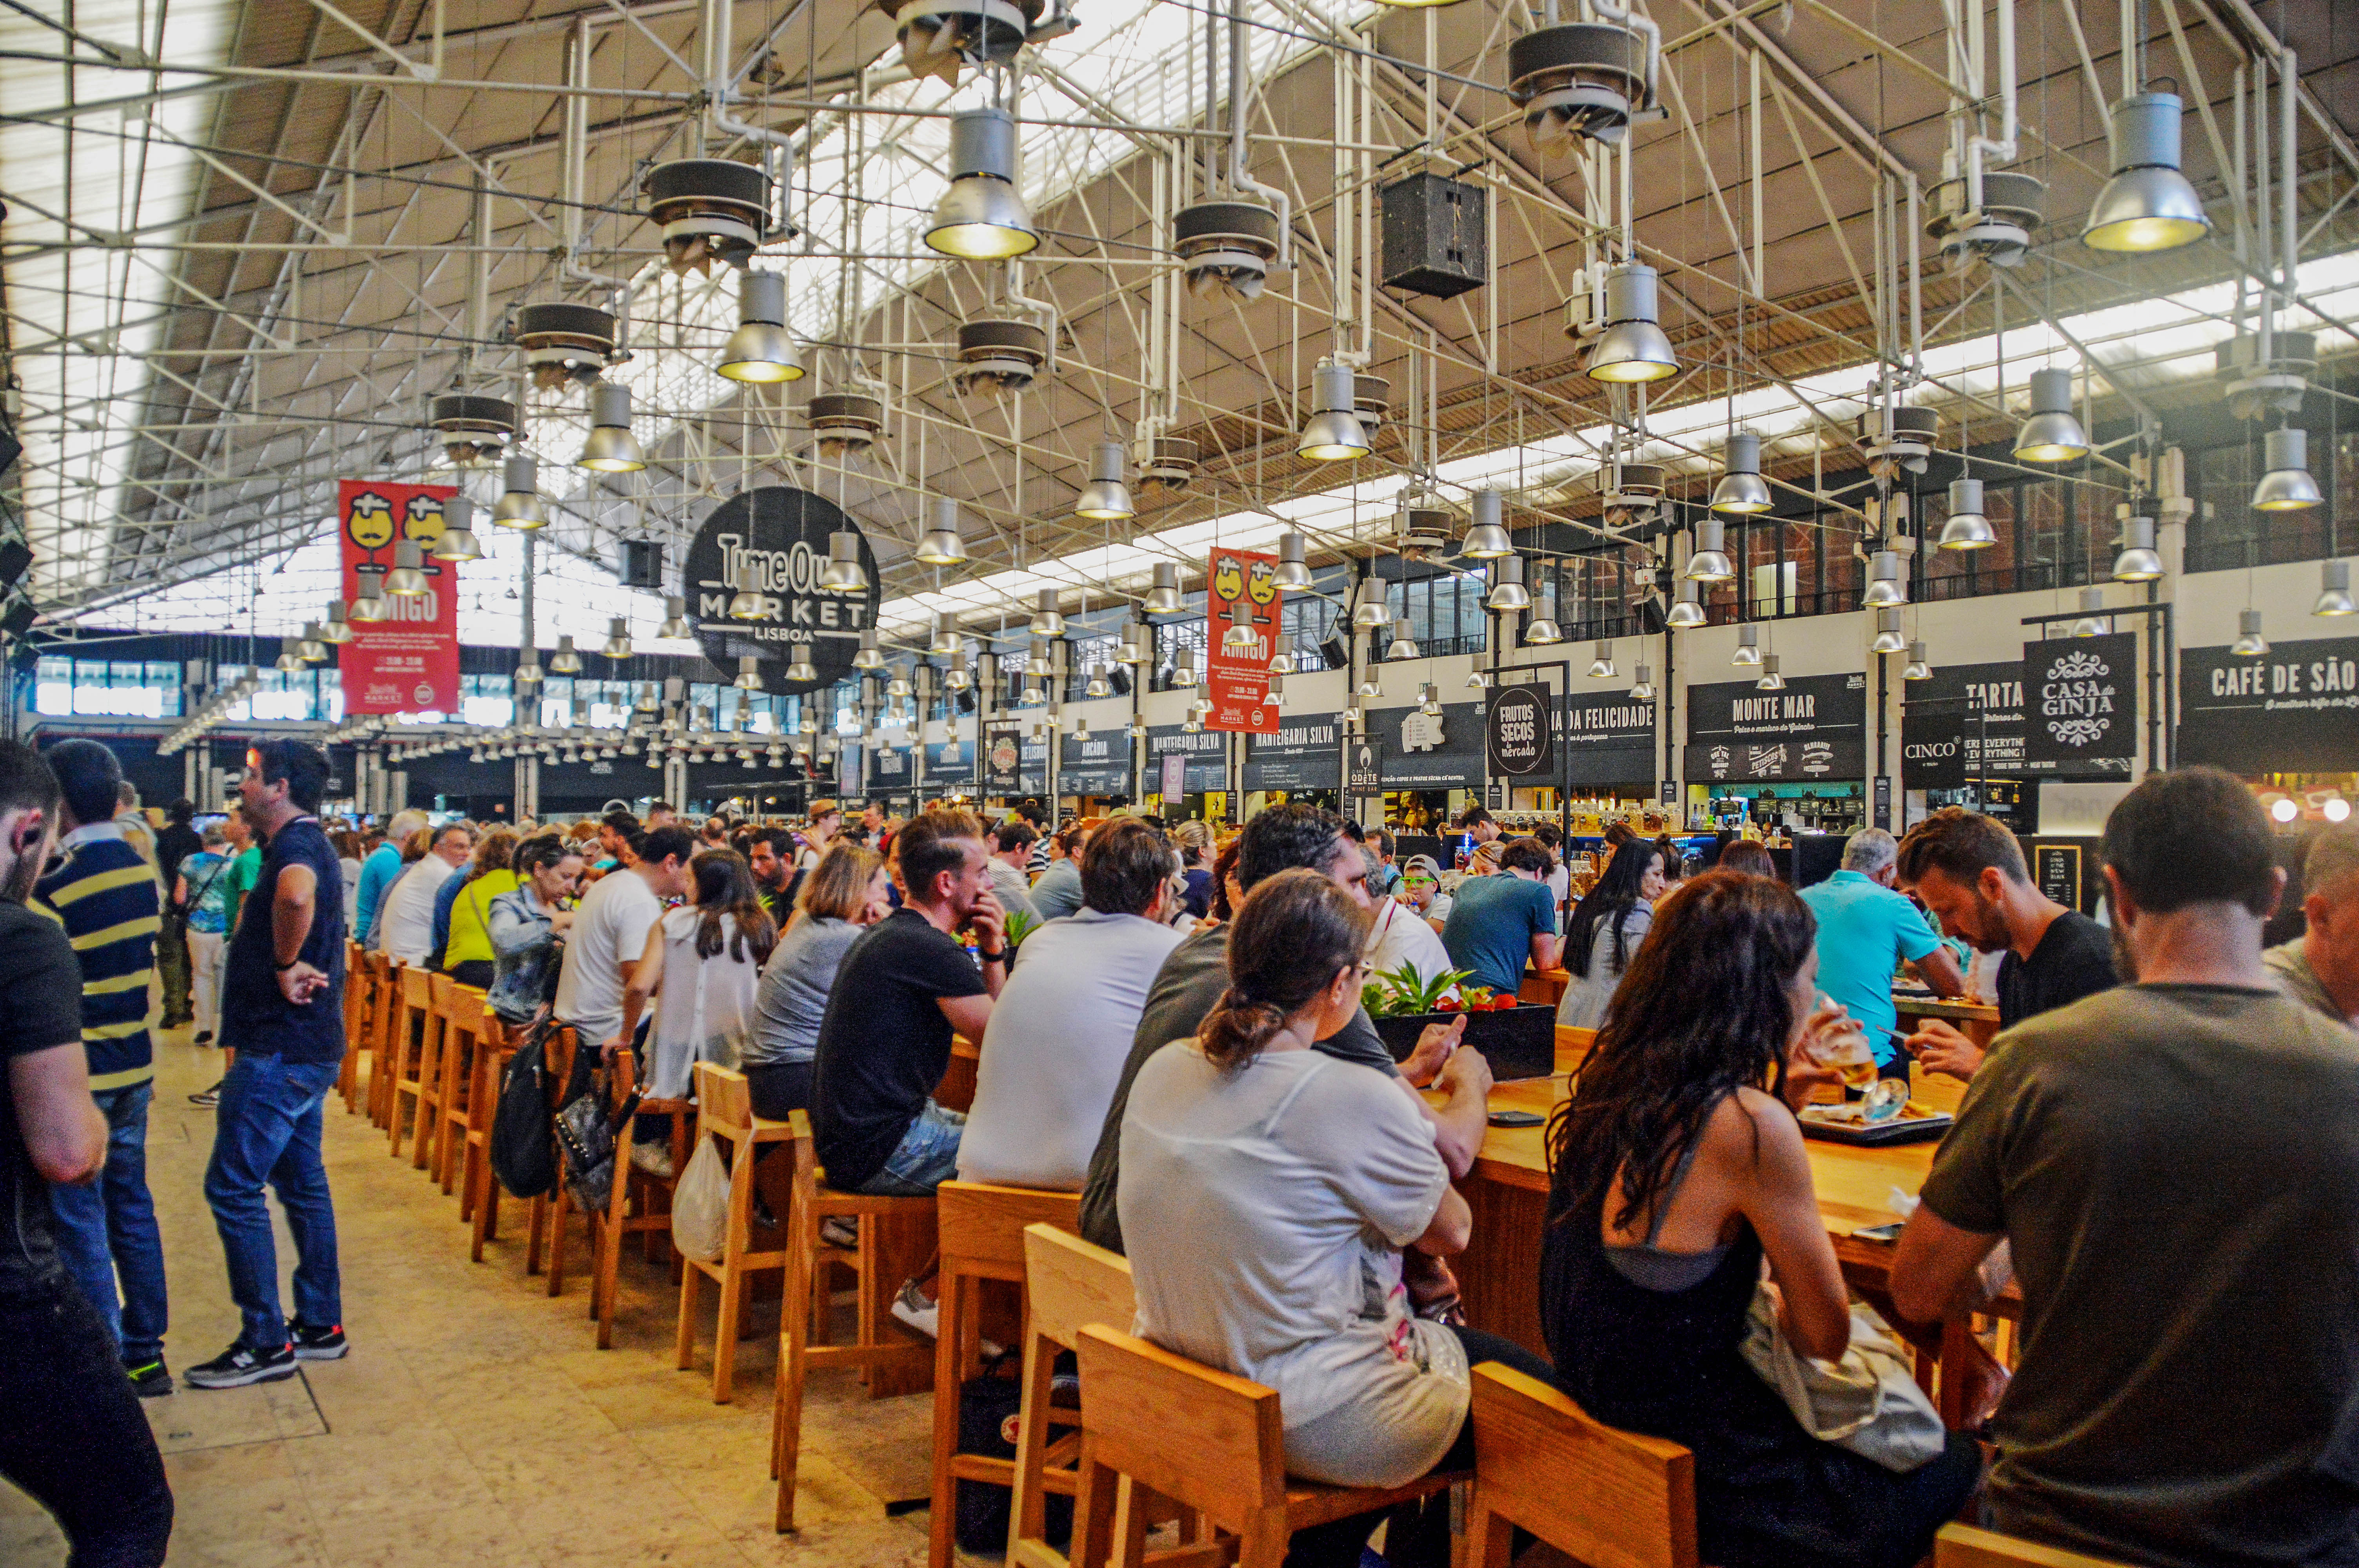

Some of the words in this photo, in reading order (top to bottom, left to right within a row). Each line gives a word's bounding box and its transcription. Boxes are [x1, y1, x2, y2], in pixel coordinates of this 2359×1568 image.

[379, 589, 438, 622] MIGO
[700, 593, 866, 628] MRKET
[755, 627, 813, 642] LISBOA
[2212, 660, 2265, 697] CAFÉ
[2272, 664, 2301, 693] DE
[2310, 656, 2356, 692] SÃO
[2042, 681, 2102, 699] CASA
[1500, 704, 1534, 722] FRUTOS
[1733, 697, 1779, 721] MONTE
[1785, 695, 1815, 718] MAR
[2042, 696, 2114, 717] GINJA
[1585, 705, 1653, 729] FELICIDADE
[1256, 727, 1308, 747] MANTEIGARIA
[1310, 726, 1334, 744] SILVA
[1501, 721, 1535, 742] SECOS
[1789, 723, 1816, 733] Guincho
[1082, 739, 1107, 756] ARCÁDIA
[1153, 734, 1197, 753] MANTEIGARIA
[1199, 733, 1219, 750] SILVA
[1502, 740, 1535, 757] mercado
[1905, 742, 1956, 759] CINCO
[1964, 739, 1980, 749] ERE
[1985, 737, 2025, 748] EVERYTHI
[1752, 751, 1779, 770] PETISCOS
[1970, 748, 2020, 759] EVRYTHING
[1352, 773, 1378, 784] ODETE
